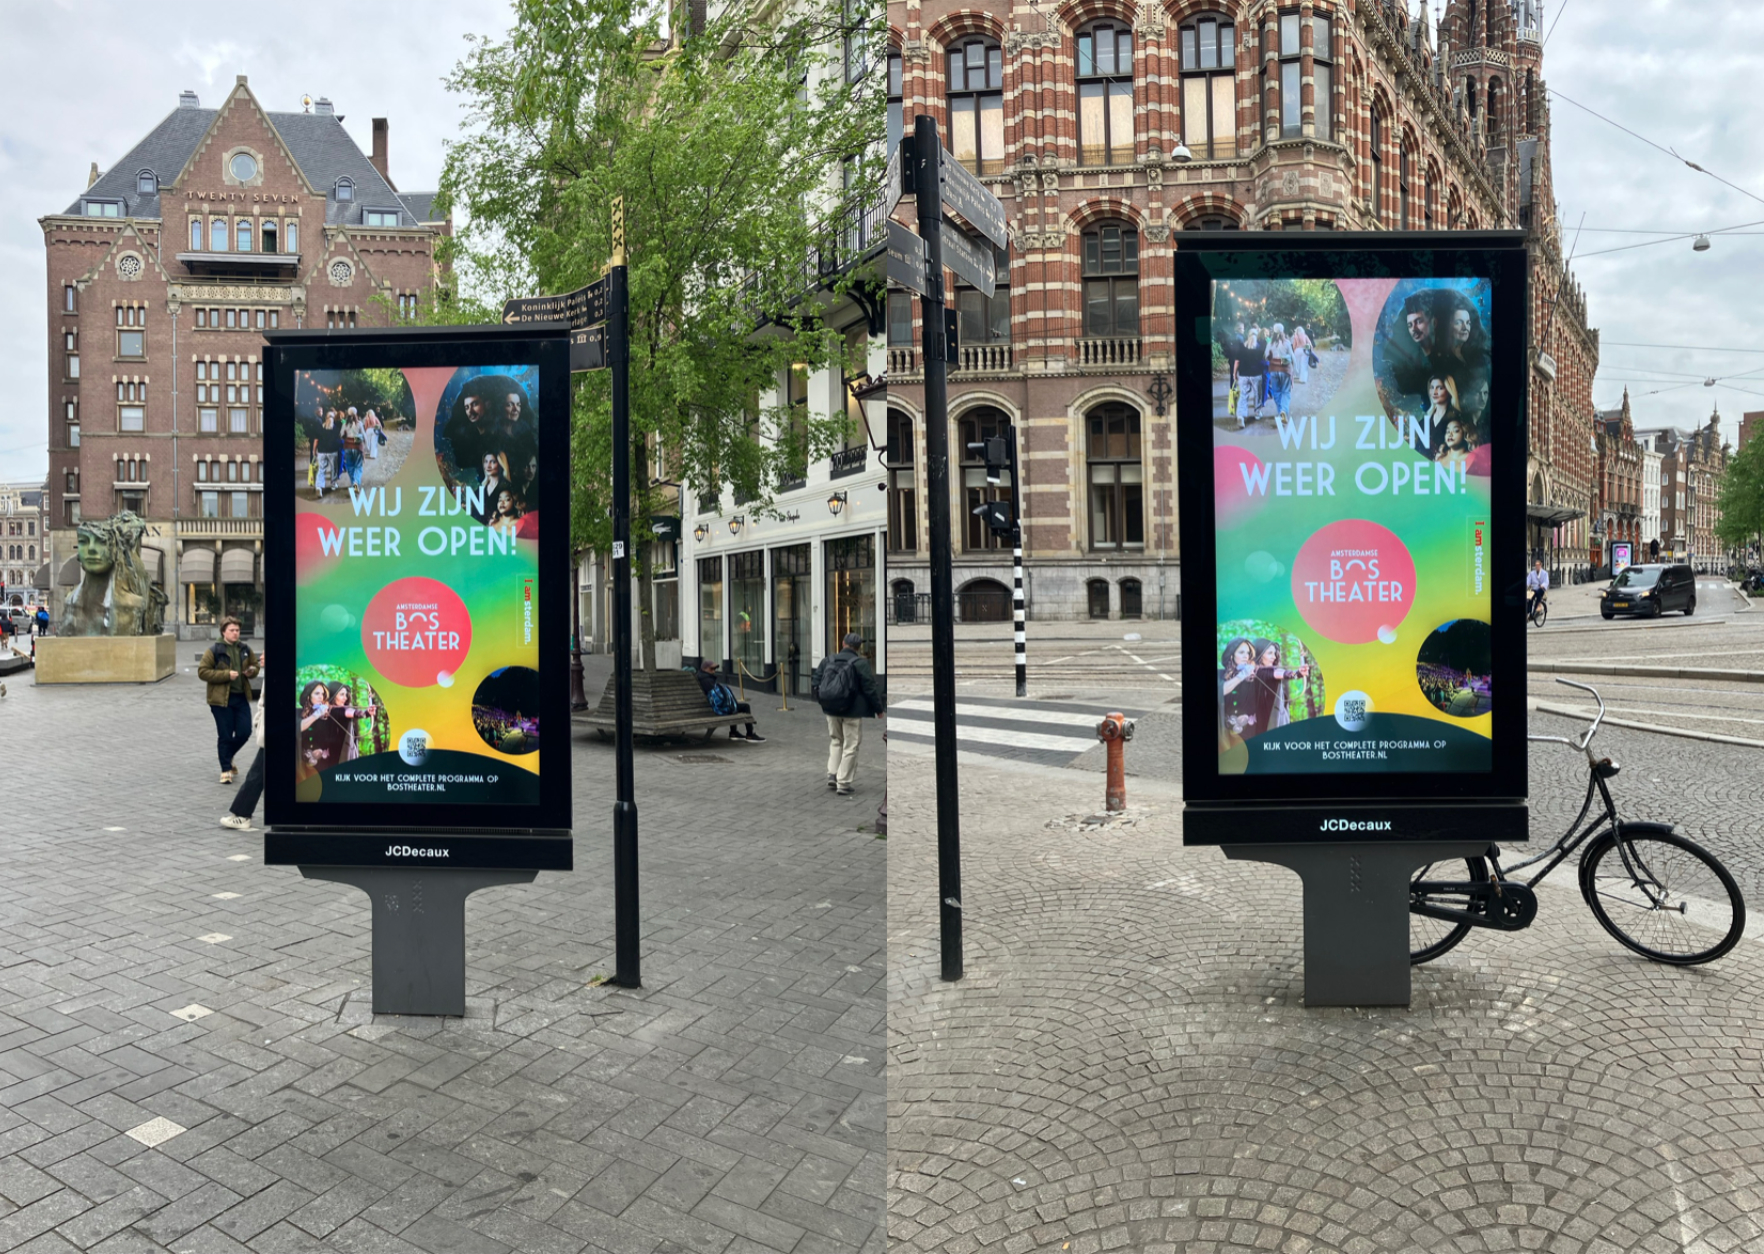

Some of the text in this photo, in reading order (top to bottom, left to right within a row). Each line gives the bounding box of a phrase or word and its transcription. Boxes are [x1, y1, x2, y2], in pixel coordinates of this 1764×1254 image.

[188, 190, 298, 203] TWENTY SEVEN
[521, 300, 566, 312] Koninklijk
[567, 294, 586, 306] Paleis
[534, 312, 564, 322] Nieuwe
[566, 307, 580, 318] Kerk
[1274, 415, 1432, 450] WIJ ZIJN
[1239, 460, 1467, 496] WEER OPEN!
[348, 486, 484, 517] WIJ ZIJN
[317, 525, 516, 557] WEER OPEN!
[1330, 549, 1378, 557] AMSTERDAMSE
[1330, 559, 1380, 580] BOS
[1304, 581, 1403, 602] THEATER
[396, 612, 439, 630] BOS
[373, 631, 460, 650] THEATER
[1263, 740, 1447, 751] KIJK VOOR HET COMPLETE PROGRAMMA OP
[1322, 750, 1388, 760] BOSTHEATER.NL
[335, 774, 499, 783] KIJK VOOR HET COMPLETE PROGRAMMA OP
[387, 783, 446, 792] BOSTHEATER.NL
[1320, 819, 1392, 831] JCDecaux
[385, 845, 450, 858] JCDecaux
